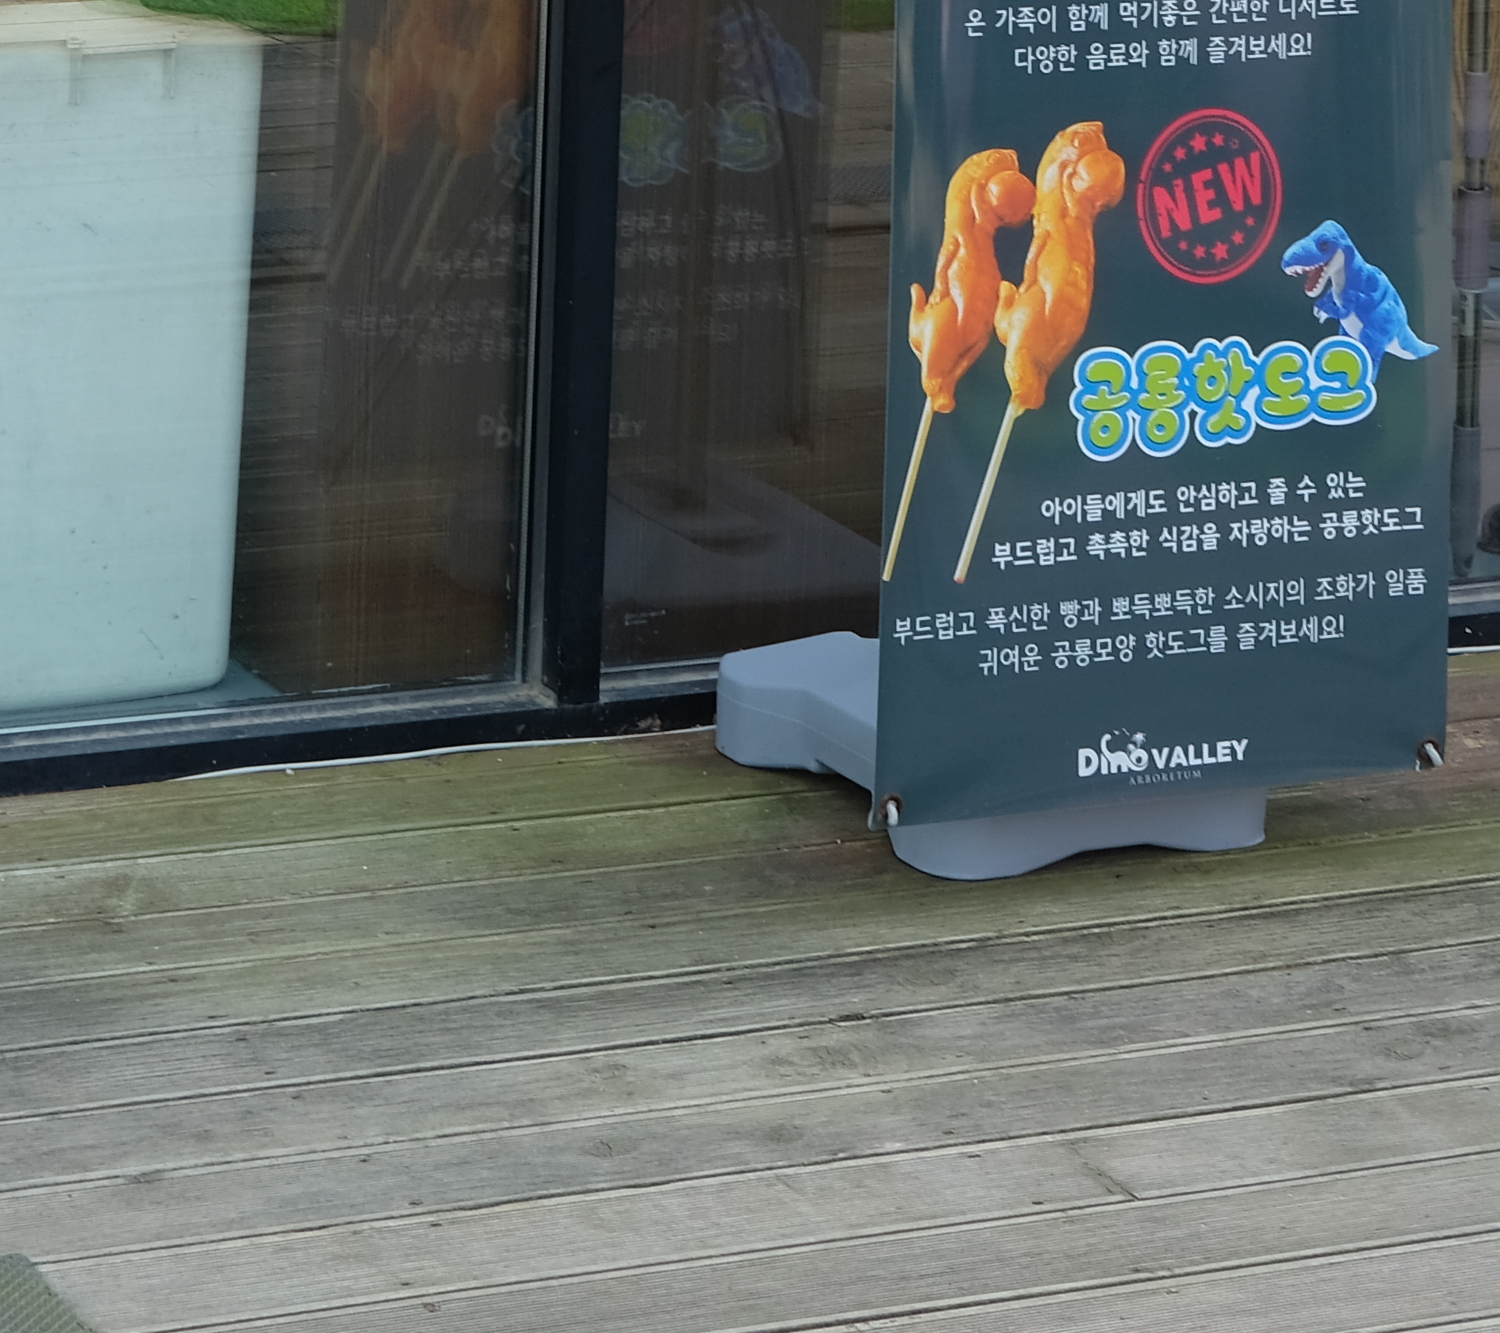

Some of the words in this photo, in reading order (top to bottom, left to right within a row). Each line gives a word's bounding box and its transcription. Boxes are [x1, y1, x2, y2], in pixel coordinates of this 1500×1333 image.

[964, 9, 986, 36] 온
[995, 5, 1056, 35] 가족이
[1067, 3, 1108, 31] 함께
[1120, 0, 1201, 28] 먹기좋은
[1015, 44, 1078, 74] 다양한
[1086, 40, 1149, 70] 음료와
[1157, 38, 1197, 66] 함께
[1206, 33, 1311, 63] 즐겨보세요!
[1152, 151, 1263, 238] NEW
[1075, 341, 1371, 455] 공룡핫도그
[1041, 491, 1167, 525] 아이들에게도
[1177, 482, 1258, 512] 안심하고
[1267, 478, 1288, 505] 줄
[1296, 475, 1317, 502] 수
[1326, 472, 1366, 499] 있는
[992, 537, 1077, 570] 부드럽고
[1086, 529, 1150, 560] 촉촉한
[1159, 523, 1220, 553] 식감을
[1229, 516, 1311, 547] 자랑하는
[1319, 507, 1424, 539] 공룡핫도그
[893, 611, 977, 645] 부드럽고
[985, 603, 1050, 634] 폭신한
[1060, 598, 1102, 628] 빵과
[1111, 587, 1215, 620] 뽀득뽀득한
[1223, 578, 1304, 609] 소시지의
[1314, 571, 1375, 601] 조화가
[1385, 568, 1427, 596] 일품
[1151, 738, 1248, 767] VALLEY
